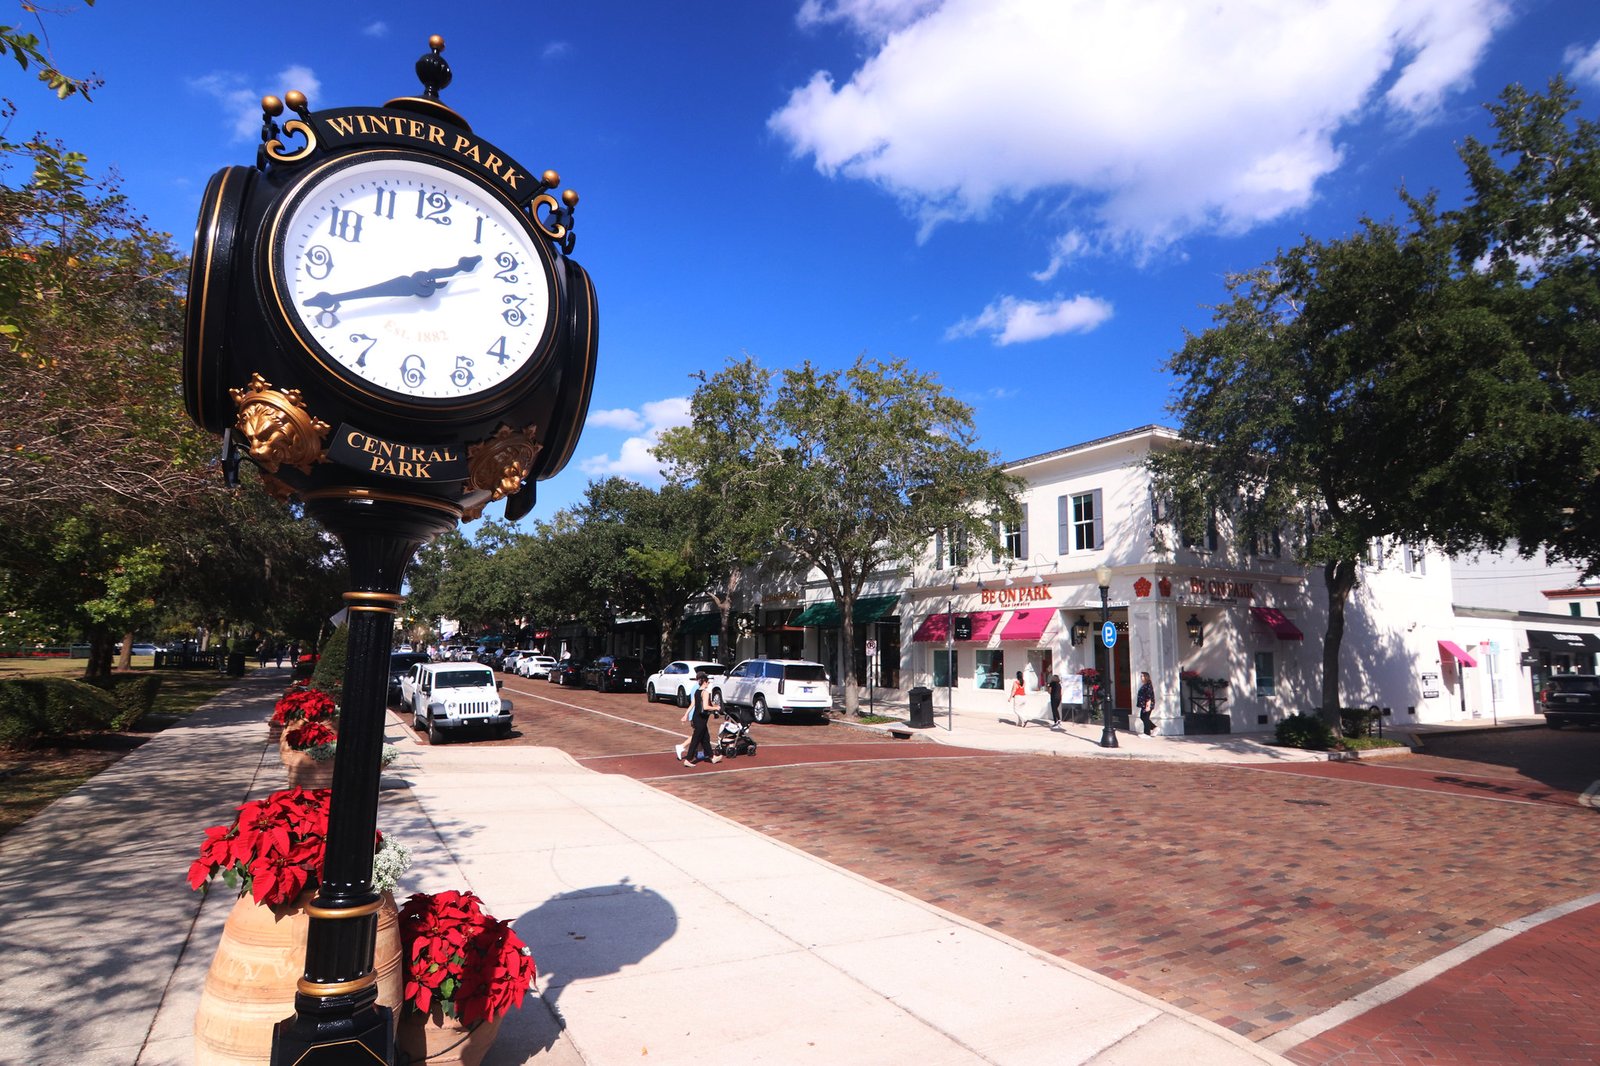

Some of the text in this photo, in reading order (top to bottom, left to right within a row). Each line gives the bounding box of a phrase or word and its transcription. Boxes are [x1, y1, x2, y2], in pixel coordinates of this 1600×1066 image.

[326, 114, 526, 190] WINTER PARK
[373, 186, 397, 220] 11
[416, 189, 452, 226] 12
[328, 206, 364, 243] 10
[473, 215, 484, 244] 1
[304, 244, 335, 280] 9
[493, 252, 519, 284] 2
[501, 294, 528, 327] 3
[349, 333, 377, 368] 7
[486, 336, 510, 365] 4
[400, 354, 426, 388] 6
[449, 356, 475, 387] 5
[347, 431, 458, 462] CENTRAL
[369, 456, 431, 478] PARK
[981, 583, 1052, 604] BE ON PARK
